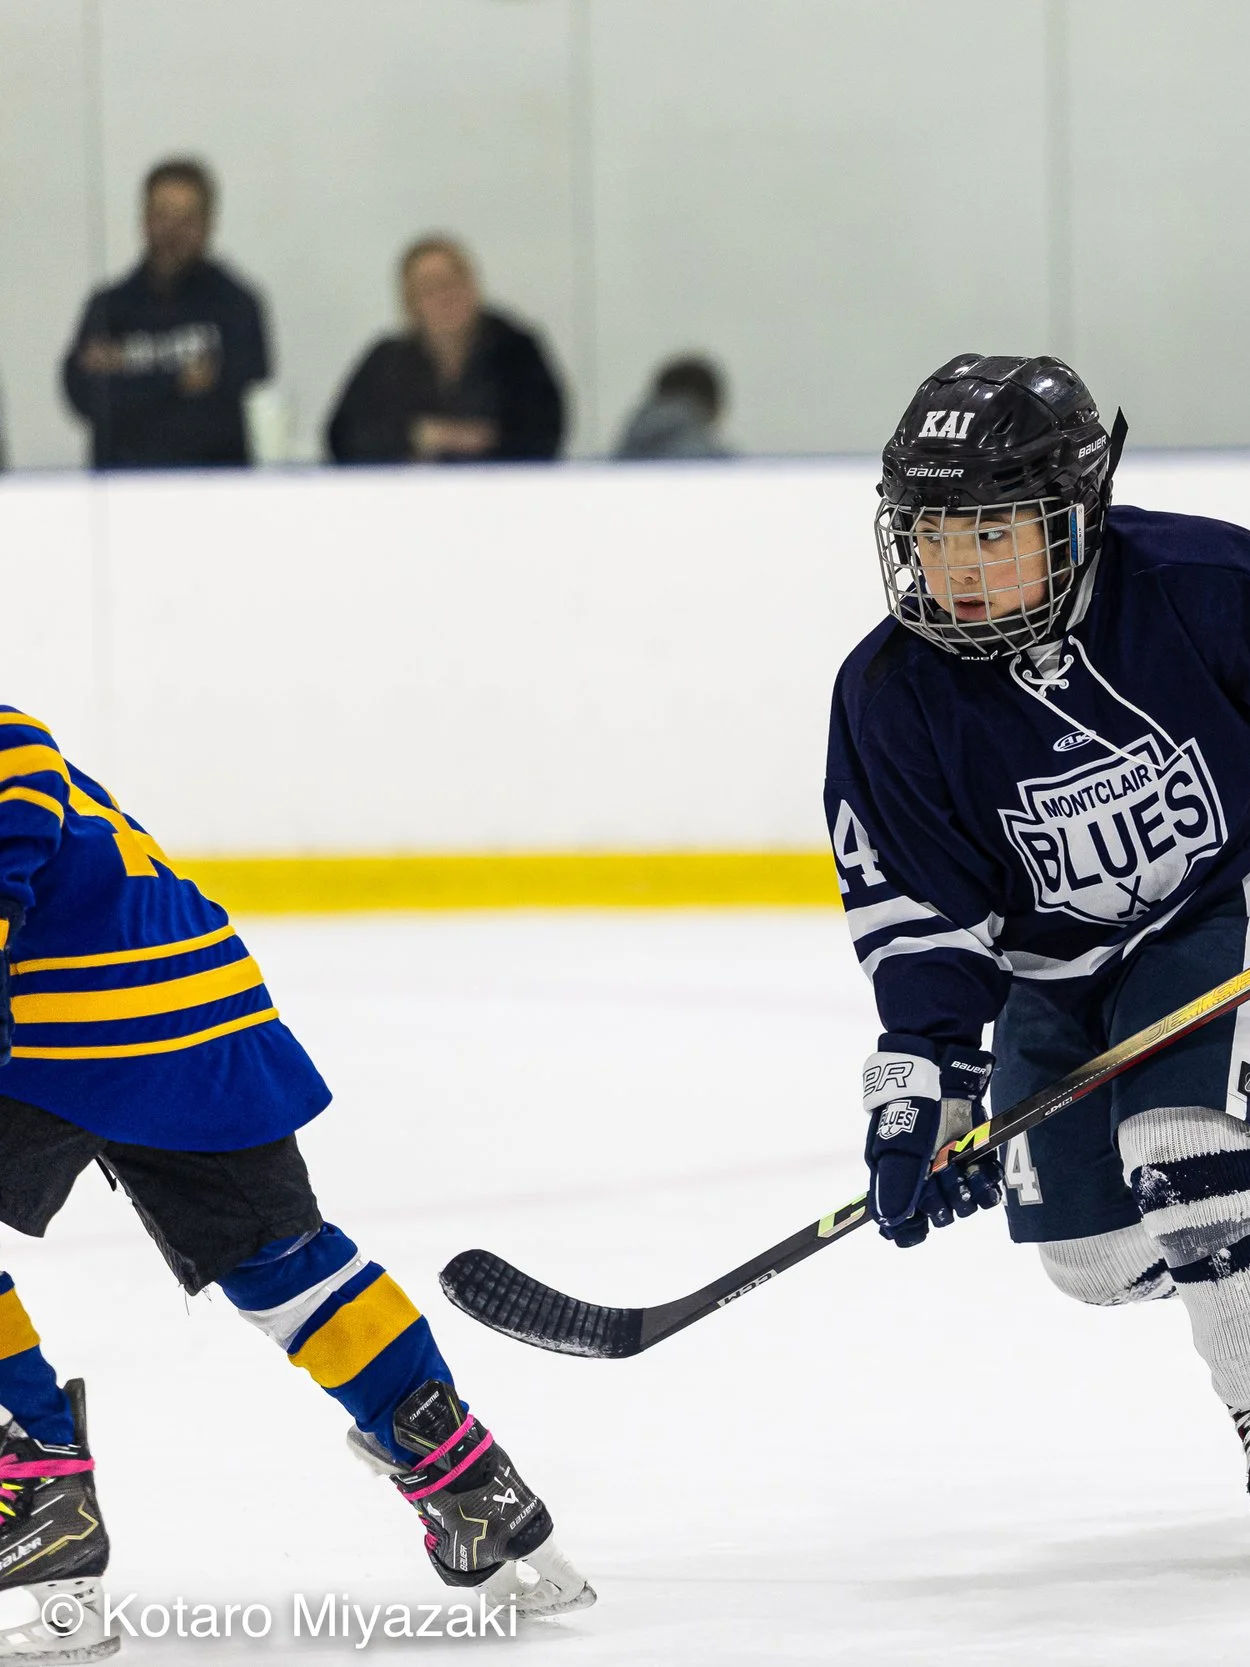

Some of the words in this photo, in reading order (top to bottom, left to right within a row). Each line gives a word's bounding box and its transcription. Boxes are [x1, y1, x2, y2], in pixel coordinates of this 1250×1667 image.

[918, 410, 975, 439] KAI
[1077, 434, 1108, 460] BAUER
[906, 466, 964, 478] BAUER
[1041, 763, 1153, 819] MONTCLAIR
[834, 799, 888, 893] 4
[1017, 770, 1209, 894] BLUES
[951, 1060, 987, 1076] BAUER
[1002, 1130, 1044, 1206] 4
[724, 1272, 774, 1304] CCM
[0, 1536, 43, 1571] AUER
